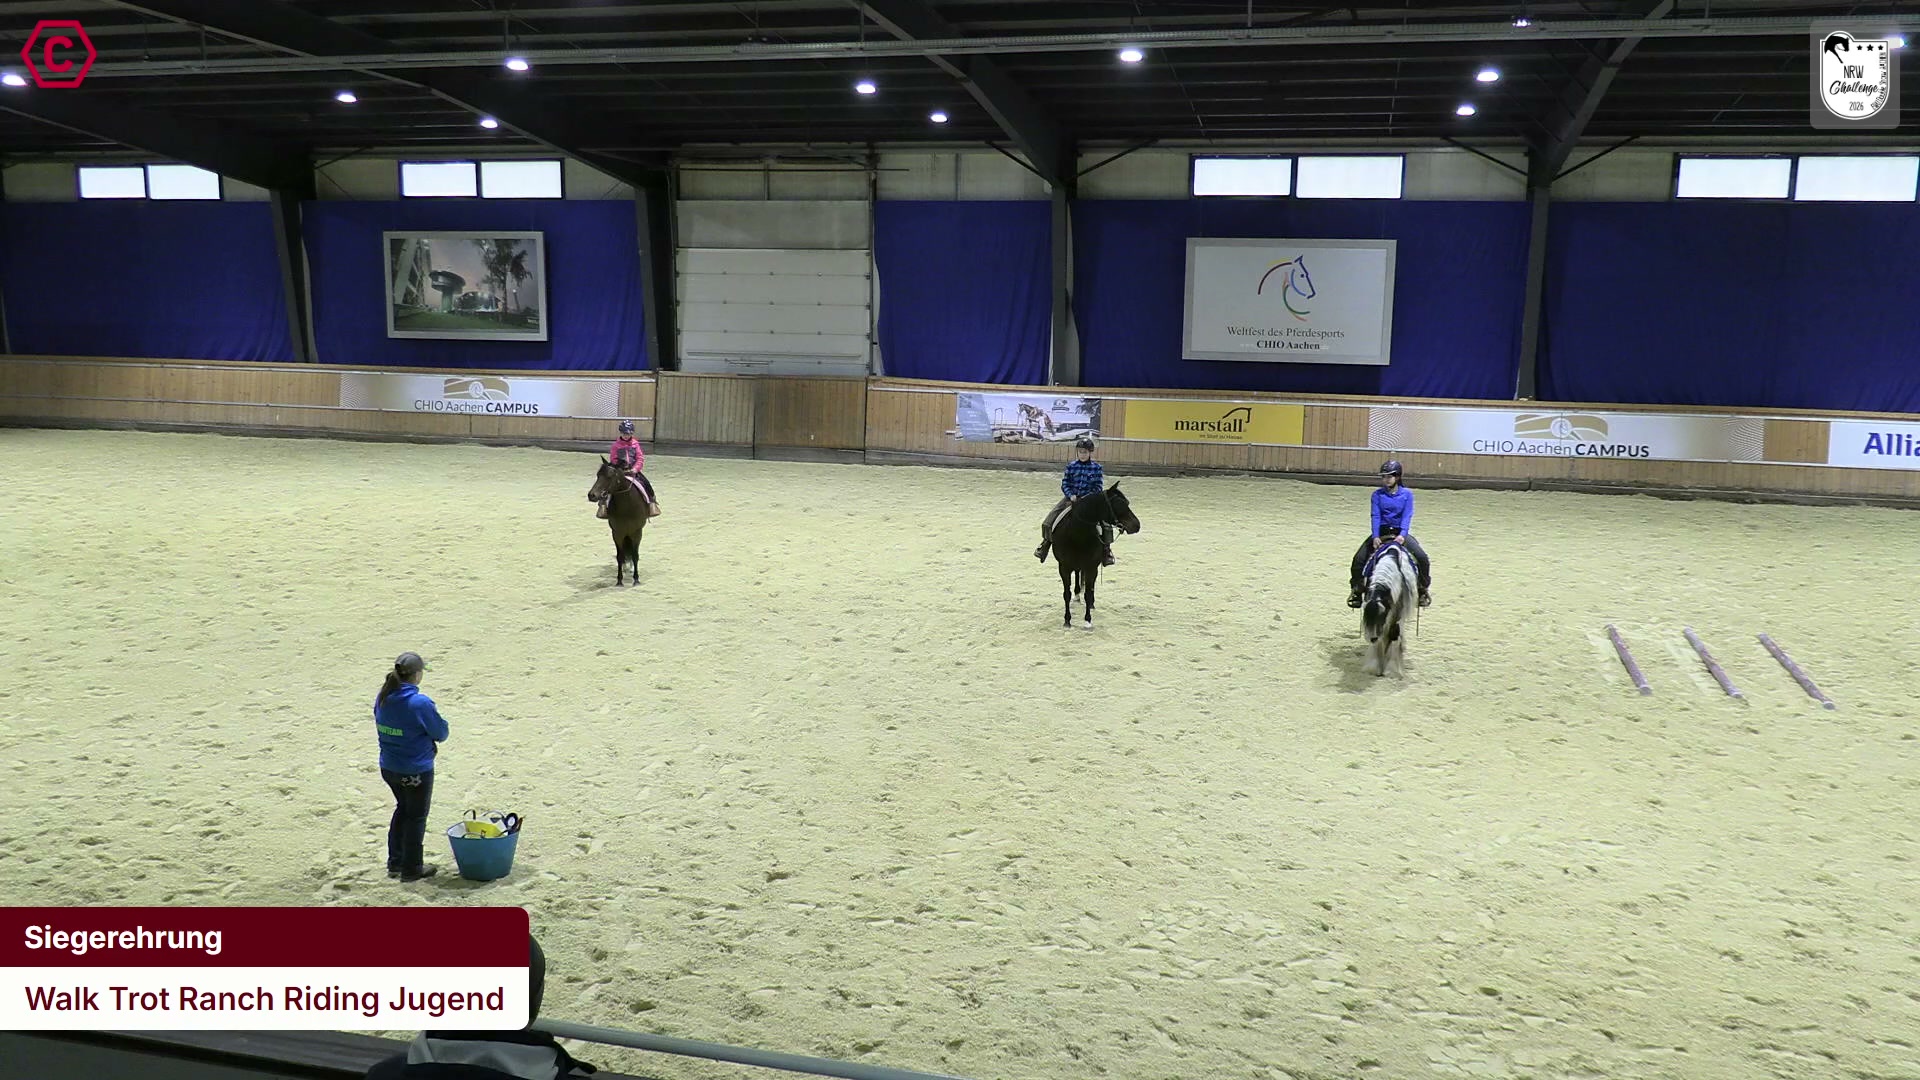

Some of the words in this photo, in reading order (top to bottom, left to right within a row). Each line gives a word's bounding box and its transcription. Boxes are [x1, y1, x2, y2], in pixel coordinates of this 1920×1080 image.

[1227, 326, 1265, 337] Weltfest
[1267, 327, 1283, 337] des
[1286, 328, 1345, 340] Pferdesports
[1256, 340, 1285, 349] CHIO
[1286, 341, 1320, 350] Aachen
[414, 399, 444, 412] CHIO
[446, 400, 484, 414] Aachen
[485, 402, 539, 415] CAMPUS
[1174, 418, 1243, 432] marstall
[1472, 439, 1514, 454] CHIO
[1516, 439, 1572, 457] Aachen
[1575, 442, 1650, 458] CAMPUS
